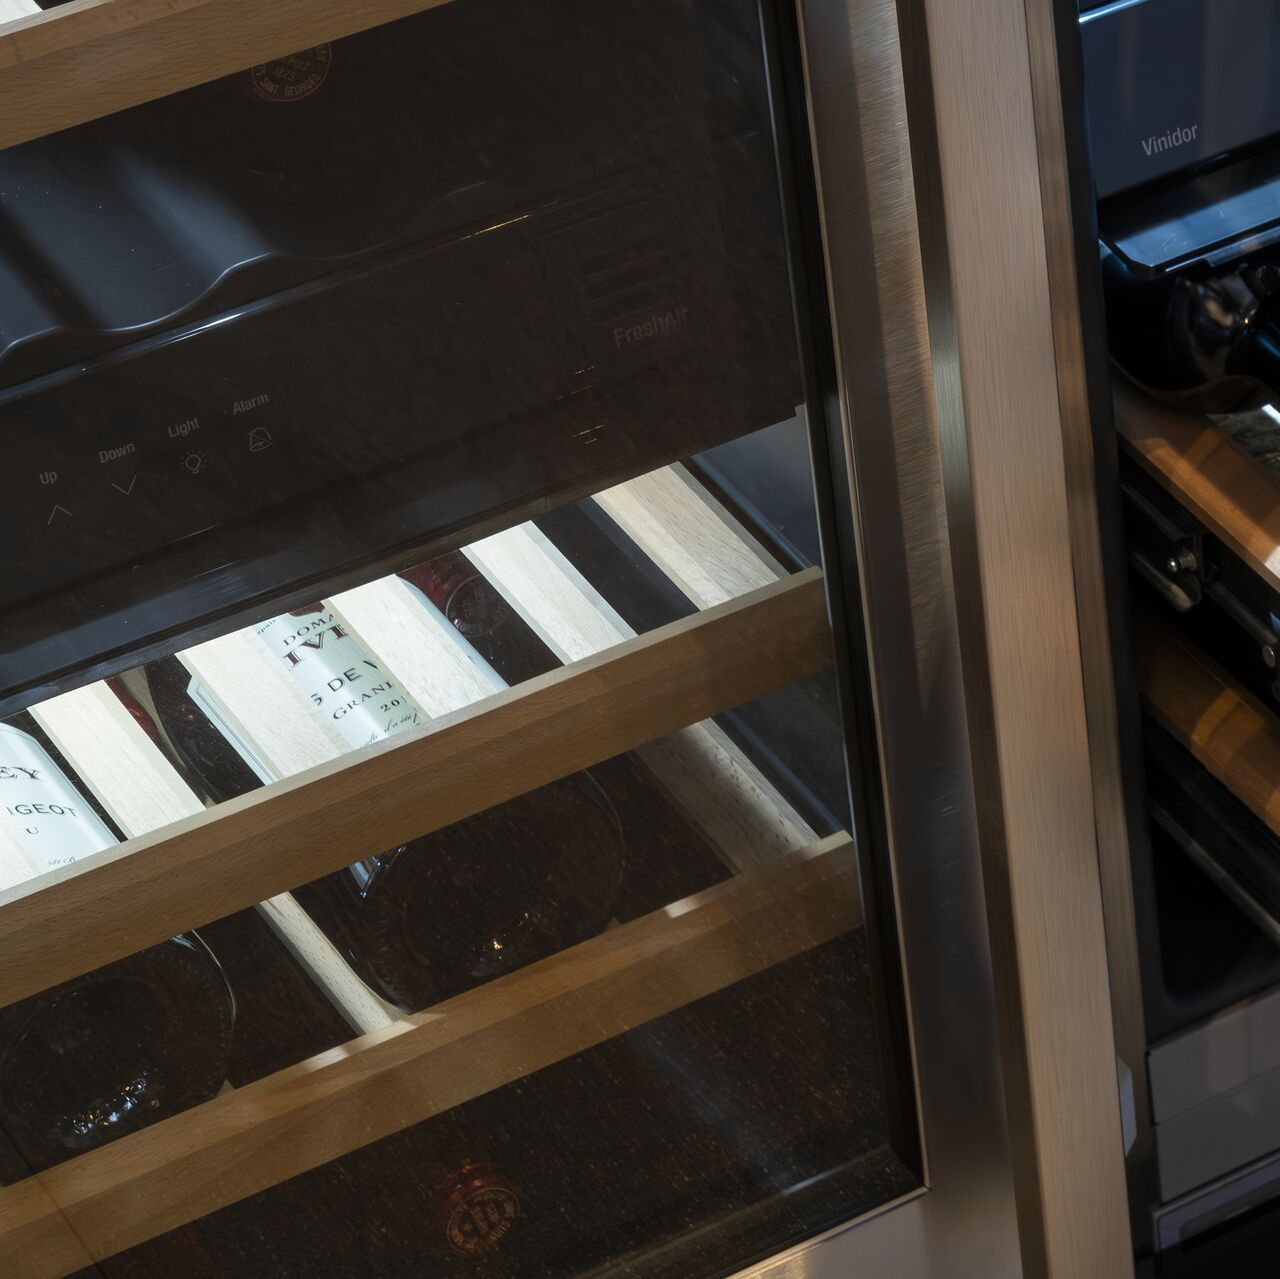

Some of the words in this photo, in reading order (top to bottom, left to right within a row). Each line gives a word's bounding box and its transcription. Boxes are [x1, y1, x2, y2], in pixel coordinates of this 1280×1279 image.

[1141, 125, 1198, 156] Vinidor
[613, 307, 688, 348] FreshAir
[232, 393, 269, 415] Alarm
[167, 417, 200, 438] Light
[99, 442, 136, 464] Down
[39, 470, 58, 486] Up
[283, 614, 334, 646] DOMA
[327, 667, 362, 692] DE
[332, 681, 394, 720] GRAN
[0, 766, 41, 780] EY
